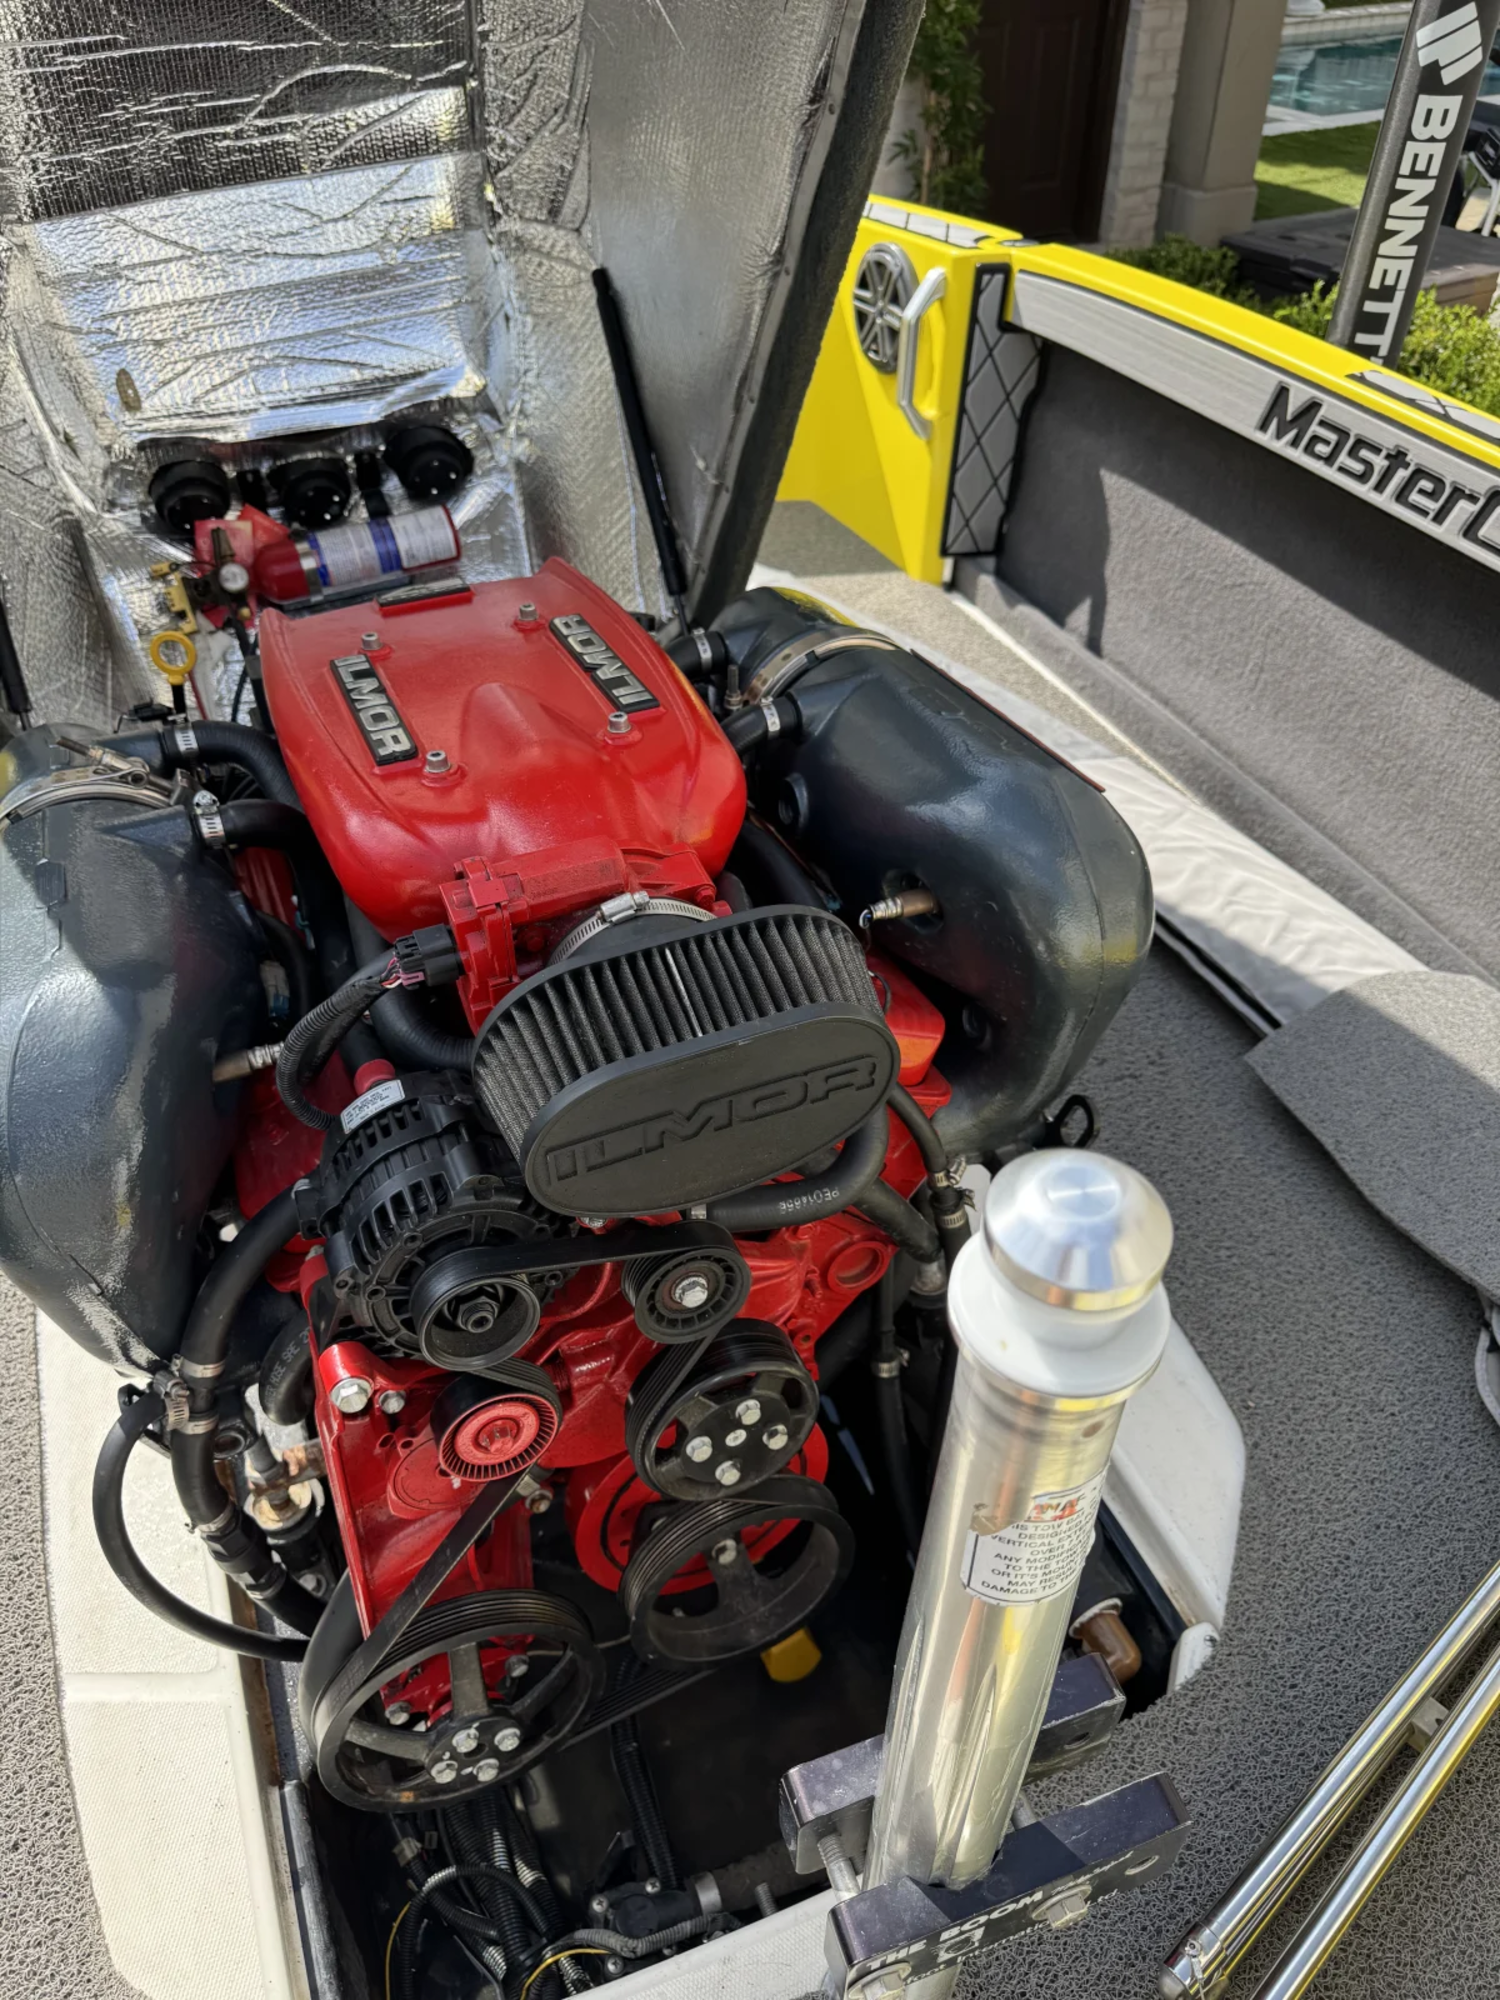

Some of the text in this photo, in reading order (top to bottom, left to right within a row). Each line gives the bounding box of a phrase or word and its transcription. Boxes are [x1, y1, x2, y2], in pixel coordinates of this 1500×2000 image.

[1354, 94, 1463, 366] BENNETT
[1255, 381, 1500, 558] MasterC
[552, 614, 652, 706] ILMOR
[334, 653, 412, 756] ILMOR
[546, 1054, 877, 1181] ILMOR
[1011, 1523, 1029, 1531] IS
[1018, 1519, 1082, 1540] DESIGNED
[991, 1534, 1055, 1549] VERTICAL
[994, 1552, 1022, 1563] ANY
[1025, 1537, 1085, 1564] MODIFICA
[1030, 1543, 1065, 1556] OVER
[991, 1568, 1011, 1578] OR
[1004, 1550, 1077, 1572] TO THE TOW
[981, 1580, 1038, 1595] DAMAGE
[1041, 1581, 1057, 1591] TO
[866, 1890, 1043, 1971] THE BOOM
[905, 1963, 946, 1986] foot
[957, 1921, 1050, 1963] Internatio
